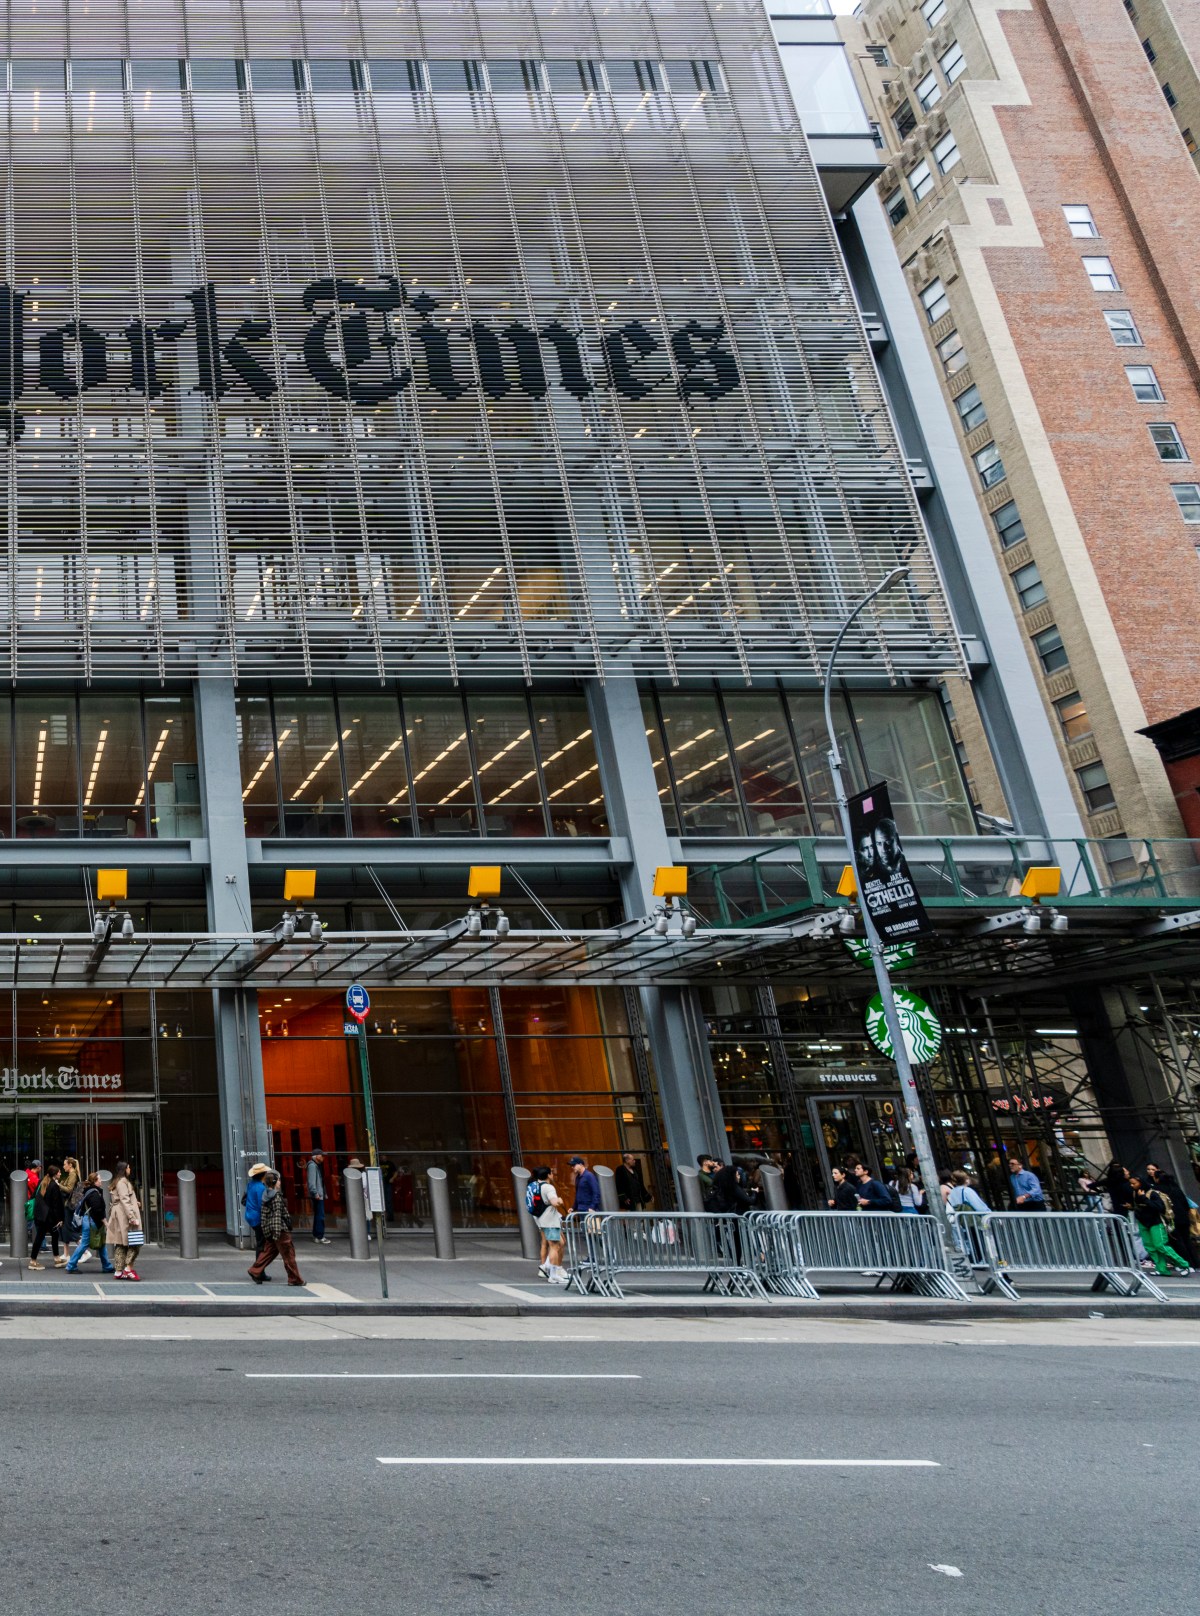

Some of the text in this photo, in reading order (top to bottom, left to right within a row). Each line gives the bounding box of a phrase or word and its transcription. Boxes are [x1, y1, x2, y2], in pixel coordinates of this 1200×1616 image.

[302, 274, 743, 409] Times
[867, 883, 914, 907] OTHELLO
[1, 1066, 54, 1096] York
[57, 1065, 122, 1090] Times
[819, 1074, 878, 1082] STARBUCKS
